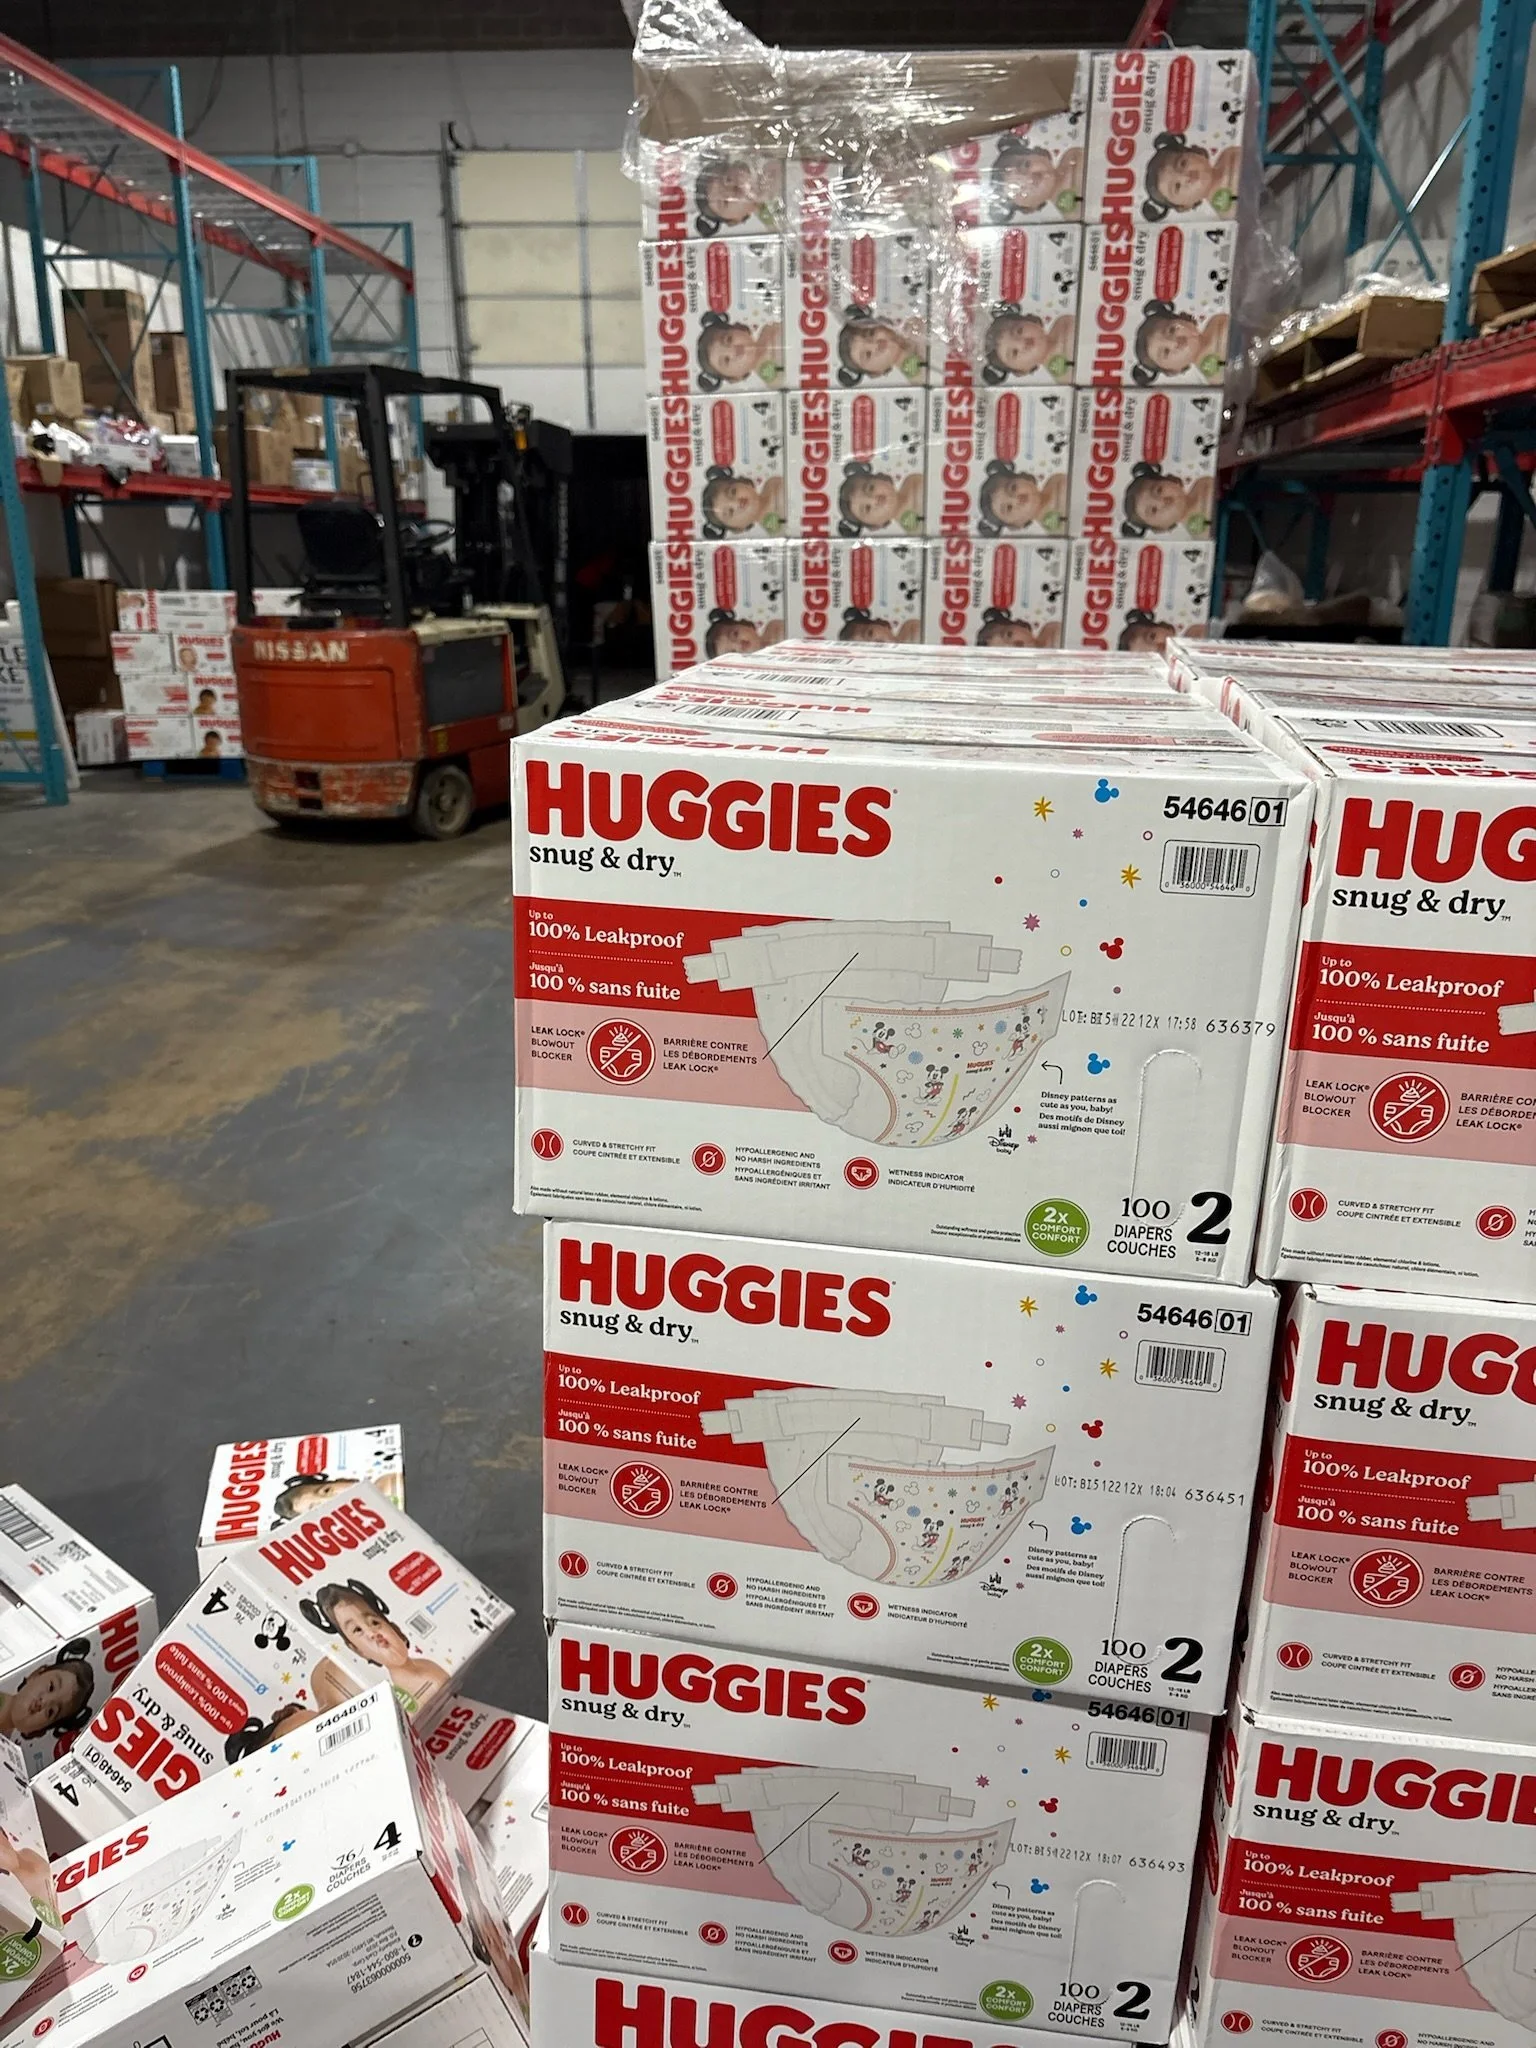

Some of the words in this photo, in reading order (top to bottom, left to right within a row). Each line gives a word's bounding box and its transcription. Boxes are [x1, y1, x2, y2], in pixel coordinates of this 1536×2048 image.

[1102, 50, 1145, 219] HUGGIES
[1092, 221, 1135, 387] HUGGIES
[662, 391, 694, 541] HUGGIES
[801, 391, 832, 541] HUGGIES
[940, 389, 974, 537] HUGGIES
[1083, 388, 1123, 538] HUGGIES
[253, 639, 349, 663] NISSAN
[525, 760, 892, 858] HUGGIES
[1163, 796, 1247, 822] 54646
[1253, 799, 1285, 825] 01
[529, 845, 594, 872] snug
[600, 847, 620, 870] &
[1332, 887, 1411, 916] snug
[1416, 888, 1440, 913] &
[528, 910, 541, 920] Up
[543, 912, 553, 920] to
[528, 921, 580, 941] 100%
[585, 926, 685, 949] Leakproof
[530, 973, 563, 990] 100
[568, 977, 585, 993] %
[589, 980, 631, 997] sans
[636, 982, 681, 1001] fuite
[531, 1026, 554, 1035] LEAK
[1167, 1016, 1196, 1031] 17:58
[1206, 1019, 1276, 1037] 636379
[531, 1038, 575, 1049] BLOWOUT
[663, 1037, 708, 1049] BARRIÈRE
[710, 1041, 748, 1052] CONTRE
[531, 1050, 572, 1061] BLOCKER
[663, 1050, 679, 1058] LES
[682, 1050, 757, 1065] DÉBORDEMENTS
[663, 1062, 686, 1071] LEAK
[1040, 1101, 1058, 1109] cute
[1070, 1104, 1088, 1112] you,
[1090, 1103, 1114, 1114] baby!
[1041, 1091, 1069, 1102] Disney
[1071, 1092, 1106, 1104] patterns
[1038, 1122, 1060, 1130] aussi
[1061, 1125, 1092, 1133] mignon
[1094, 1127, 1110, 1135] que
[1056, 1114, 1082, 1123] motifs
[1096, 1117, 1124, 1127] Disney
[573, 1139, 601, 1149] CURVED
[608, 1142, 643, 1152] STRETCHY
[573, 1149, 597, 1157] COUPE
[598, 1150, 626, 1159] CINTRÉE
[639, 1154, 681, 1164] EXTENSIBLE
[735, 1146, 798, 1158] HYPOALLERGENIC
[747, 1156, 772, 1165] HARSH
[773, 1159, 821, 1169] INGREDIENTS
[798, 1181, 831, 1190] IRRITANT
[888, 1168, 923, 1178] WETNESS
[924, 1172, 964, 1182] INDICATOR
[888, 1178, 931, 1189] INDICATEUR
[1121, 1197, 1170, 1220] 100
[1186, 1191, 1233, 1245] 2
[1032, 1222, 1082, 1236] COMFORT
[1032, 1232, 1081, 1245] CONFORT
[1114, 1225, 1173, 1242] DIAPERS
[1107, 1240, 1176, 1259] COUCHES
[560, 1238, 892, 1337] HUGGIES
[560, 1310, 620, 1335] snug
[625, 1314, 643, 1334] &
[1137, 1302, 1213, 1330] 54646
[1219, 1310, 1249, 1333] 01
[1313, 1393, 1386, 1419] snug
[1390, 1397, 1413, 1418] &
[215, 1439, 268, 1541] HUGGIES
[1150, 1484, 1176, 1498] 18:04
[1185, 1488, 1245, 1506] 636451
[258, 1498, 386, 1586] HUGGIES
[202, 1586, 229, 1615] 4
[1101, 1639, 1146, 1659] 100
[1160, 1636, 1204, 1684] 2
[1019, 1656, 1065, 1669] COMFORT
[1019, 1663, 1064, 1677] CONFORT
[1094, 1661, 1148, 1679] DIAPERS
[560, 1638, 867, 1726] HUGGIES
[1088, 1673, 1152, 1694] COUCHES
[315, 1705, 357, 1733] 54648
[561, 1698, 617, 1720] snug
[622, 1702, 639, 1719] &
[1087, 1701, 1156, 1724] 54646
[1160, 1709, 1187, 1728] 01
[161, 1713, 175, 1731] &
[174, 1725, 214, 1766] snug
[1253, 1803, 1318, 1827] snug
[1322, 1809, 1341, 1827] &
[373, 1821, 402, 1851] 4
[329, 1856, 367, 1883] DIAPERS
[1129, 1857, 1186, 1873] 636493
[326, 1863, 372, 1894] COUCHES
[1059, 1981, 1100, 2000] 100
[1113, 1981, 1151, 2021] 2
[1053, 2000, 1102, 2016] DIAPERS
[1047, 2011, 1105, 2029] COUCHES
